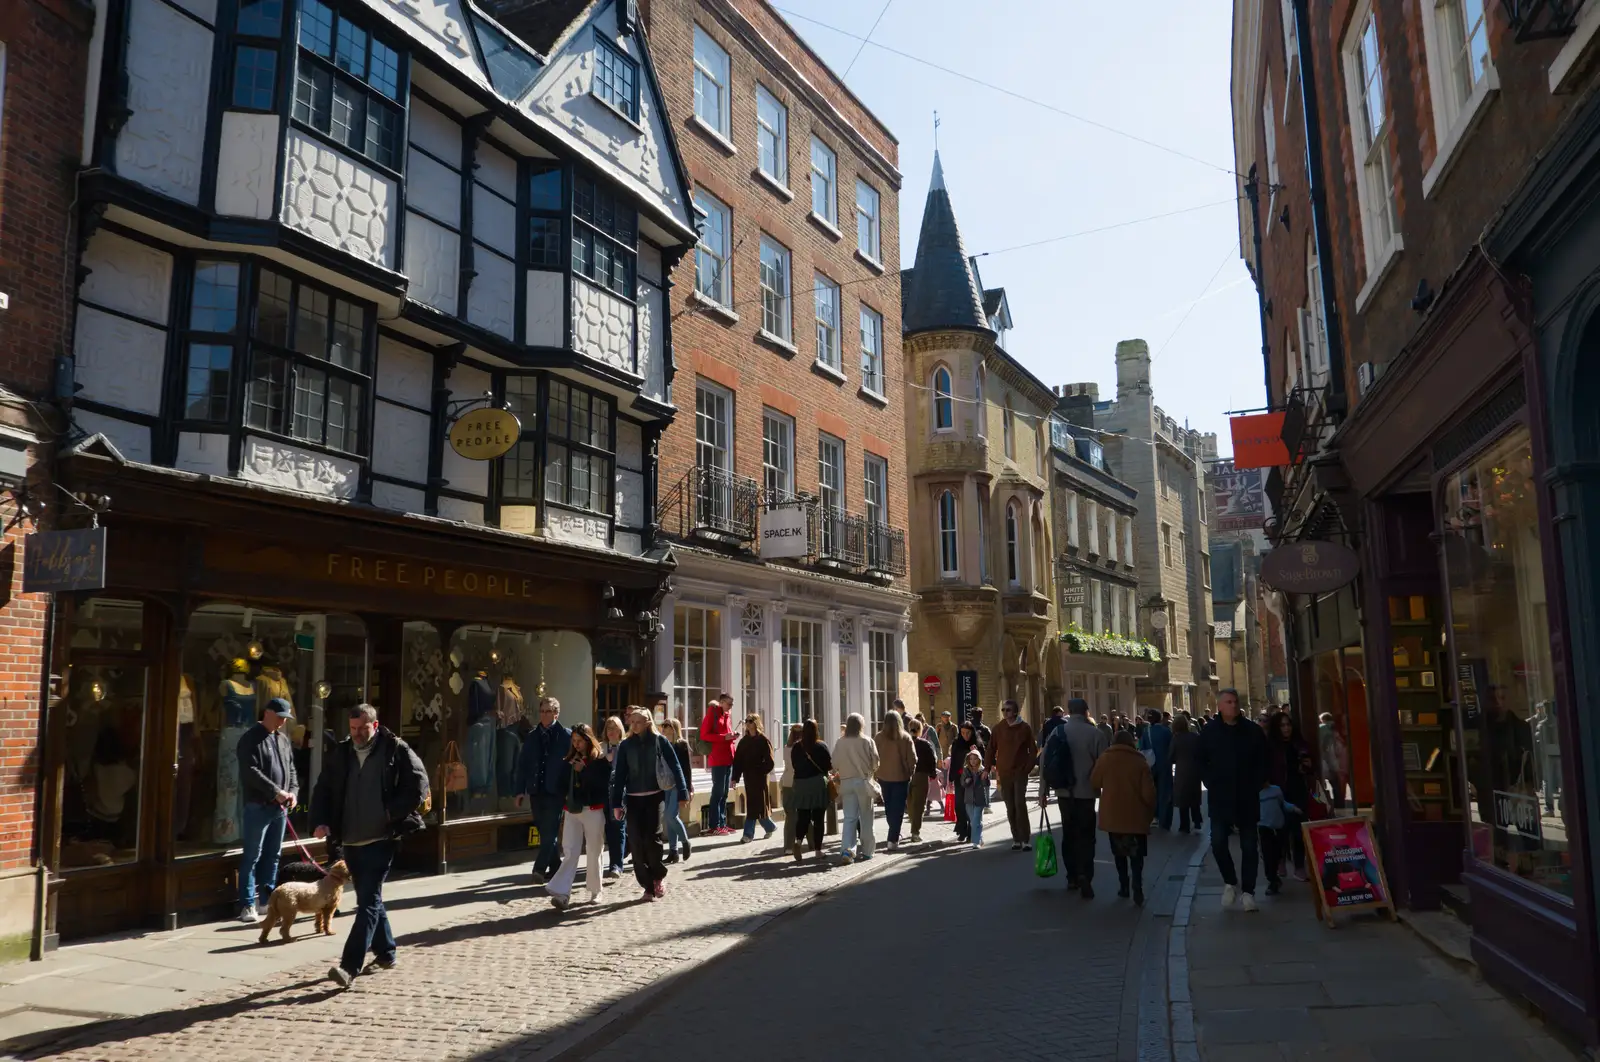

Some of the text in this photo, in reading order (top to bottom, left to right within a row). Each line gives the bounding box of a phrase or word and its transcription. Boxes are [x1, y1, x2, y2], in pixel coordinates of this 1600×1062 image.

[467, 421, 501, 432] FREE
[456, 434, 510, 447] PEOPLE
[327, 553, 533, 598] FREE PEOPLE
[1063, 586, 1084, 594] WHITE
[1064, 595, 1084, 603] STUFF
[1517, 803, 1534, 831] OFF
[1334, 854, 1366, 863] EVERYTHING
